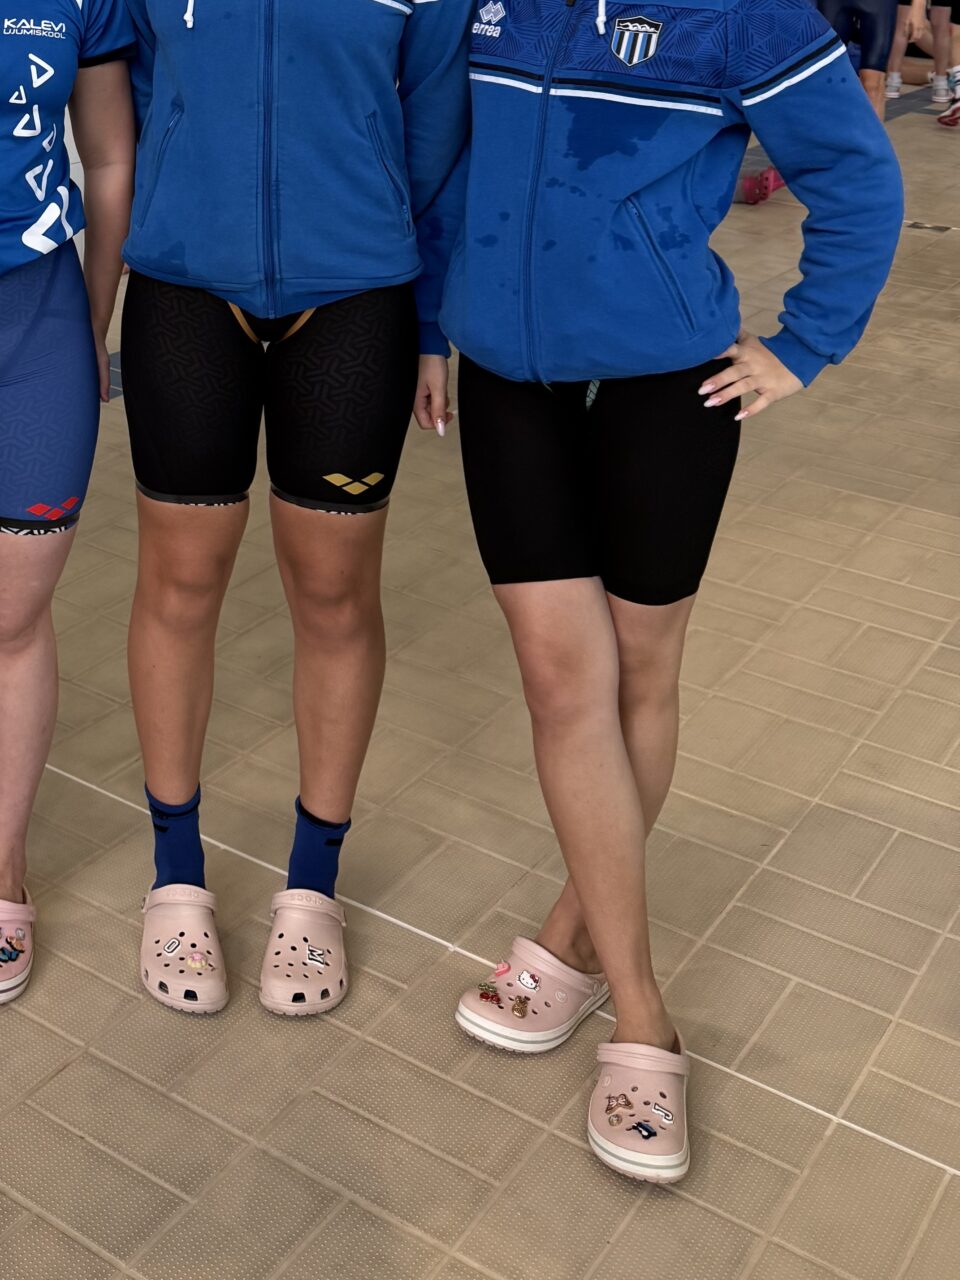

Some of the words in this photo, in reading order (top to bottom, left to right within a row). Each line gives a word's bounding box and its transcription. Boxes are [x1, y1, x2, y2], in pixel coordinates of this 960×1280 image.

[3, 18, 66, 33] KALEVI
[472, 21, 502, 38] errea
[3, 28, 66, 40] UJUMISKOOL
